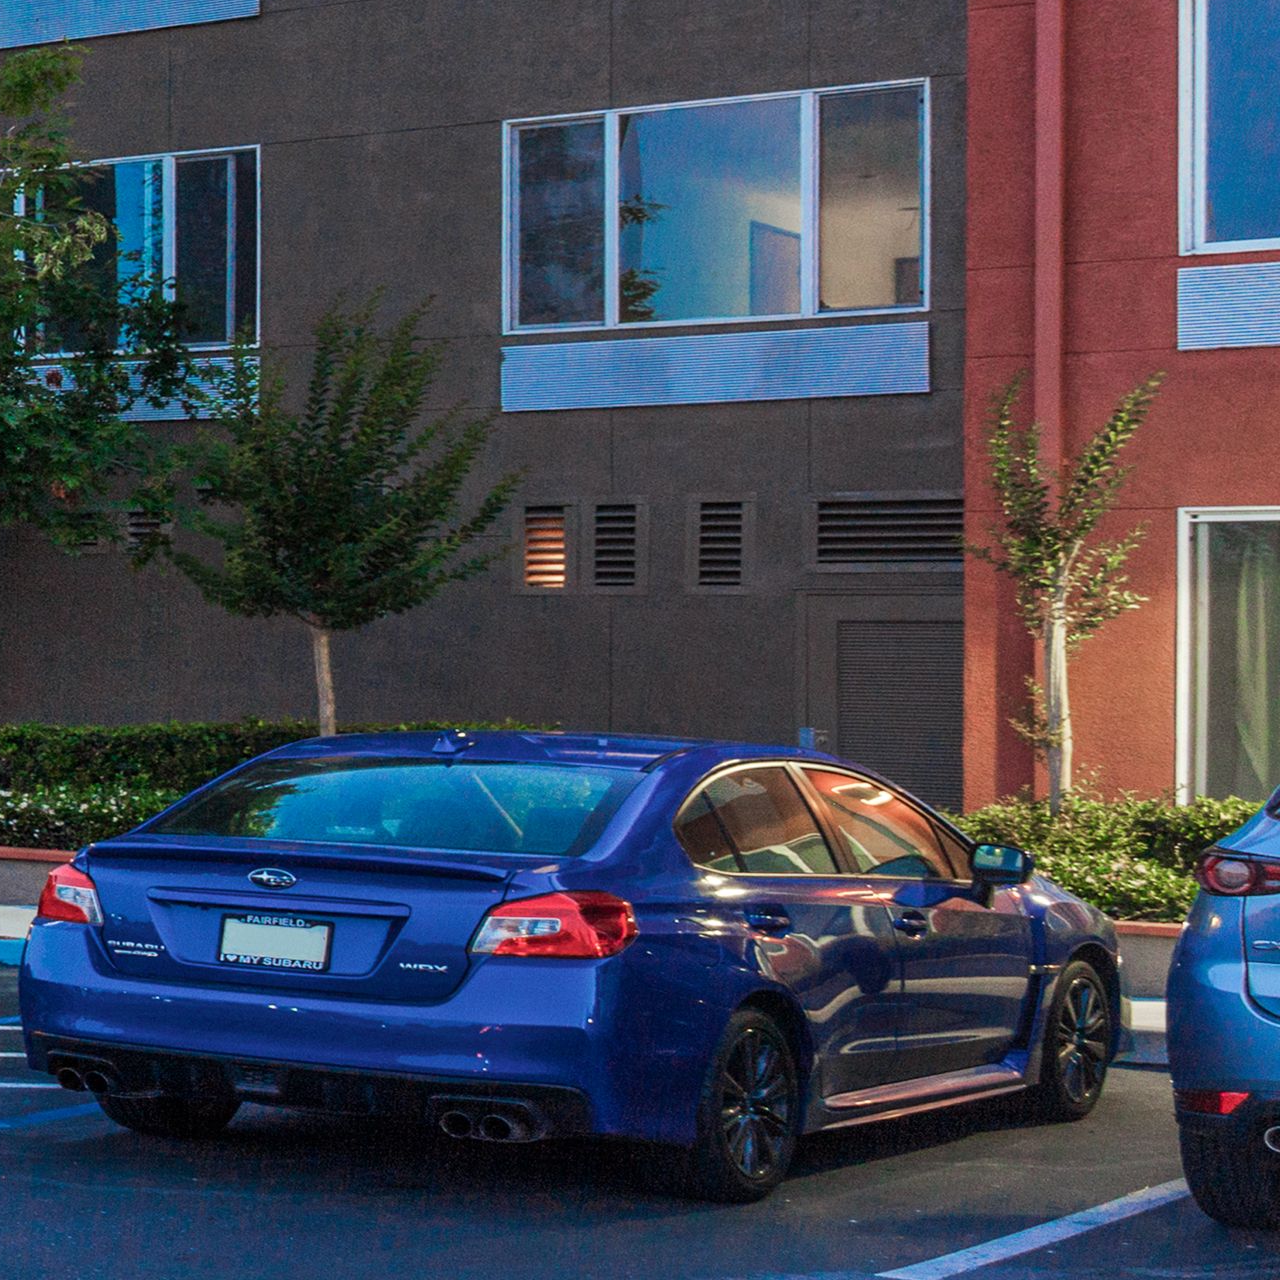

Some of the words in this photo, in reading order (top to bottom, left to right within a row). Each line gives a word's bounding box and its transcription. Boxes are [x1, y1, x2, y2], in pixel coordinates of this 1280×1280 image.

[246, 914, 305, 928] FAIRFIELD
[239, 955, 260, 965] MY
[262, 956, 324, 971] SUBARU
